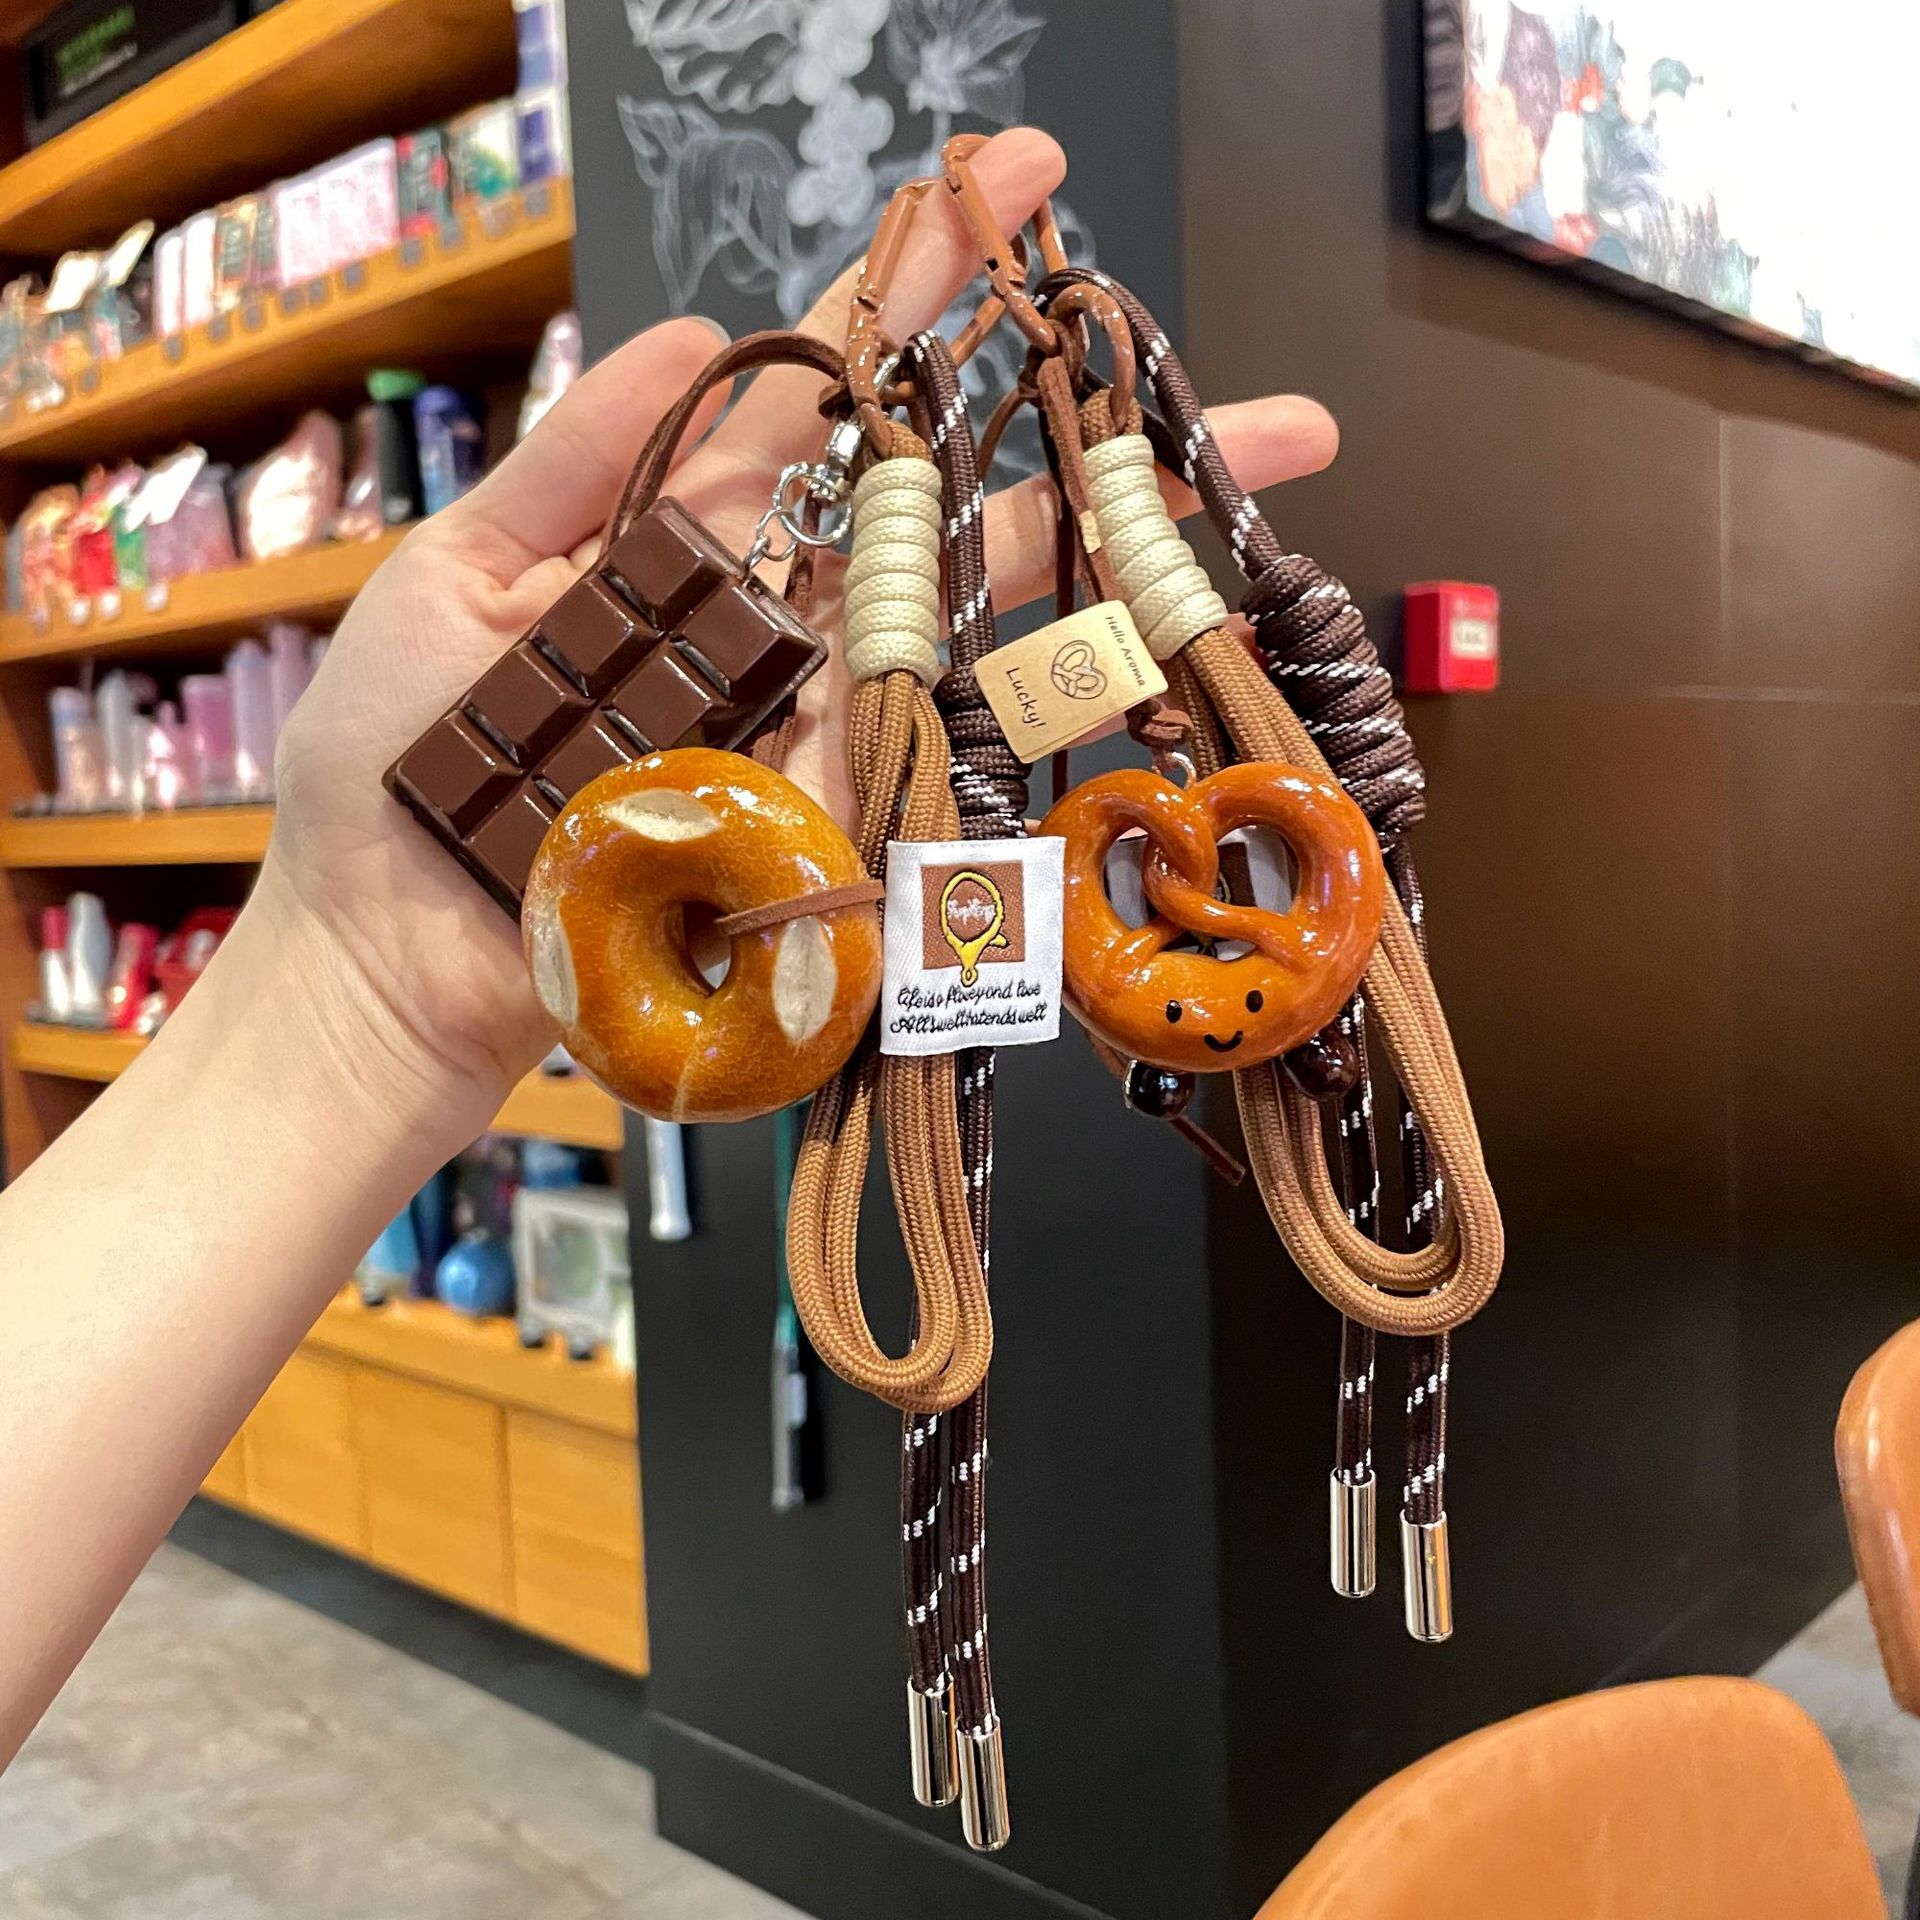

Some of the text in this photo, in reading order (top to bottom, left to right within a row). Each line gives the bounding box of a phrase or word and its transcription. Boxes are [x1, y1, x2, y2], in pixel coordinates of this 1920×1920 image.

[1105, 615, 1145, 686] Hello Aroma
[1006, 667, 1047, 729] Lucky!
